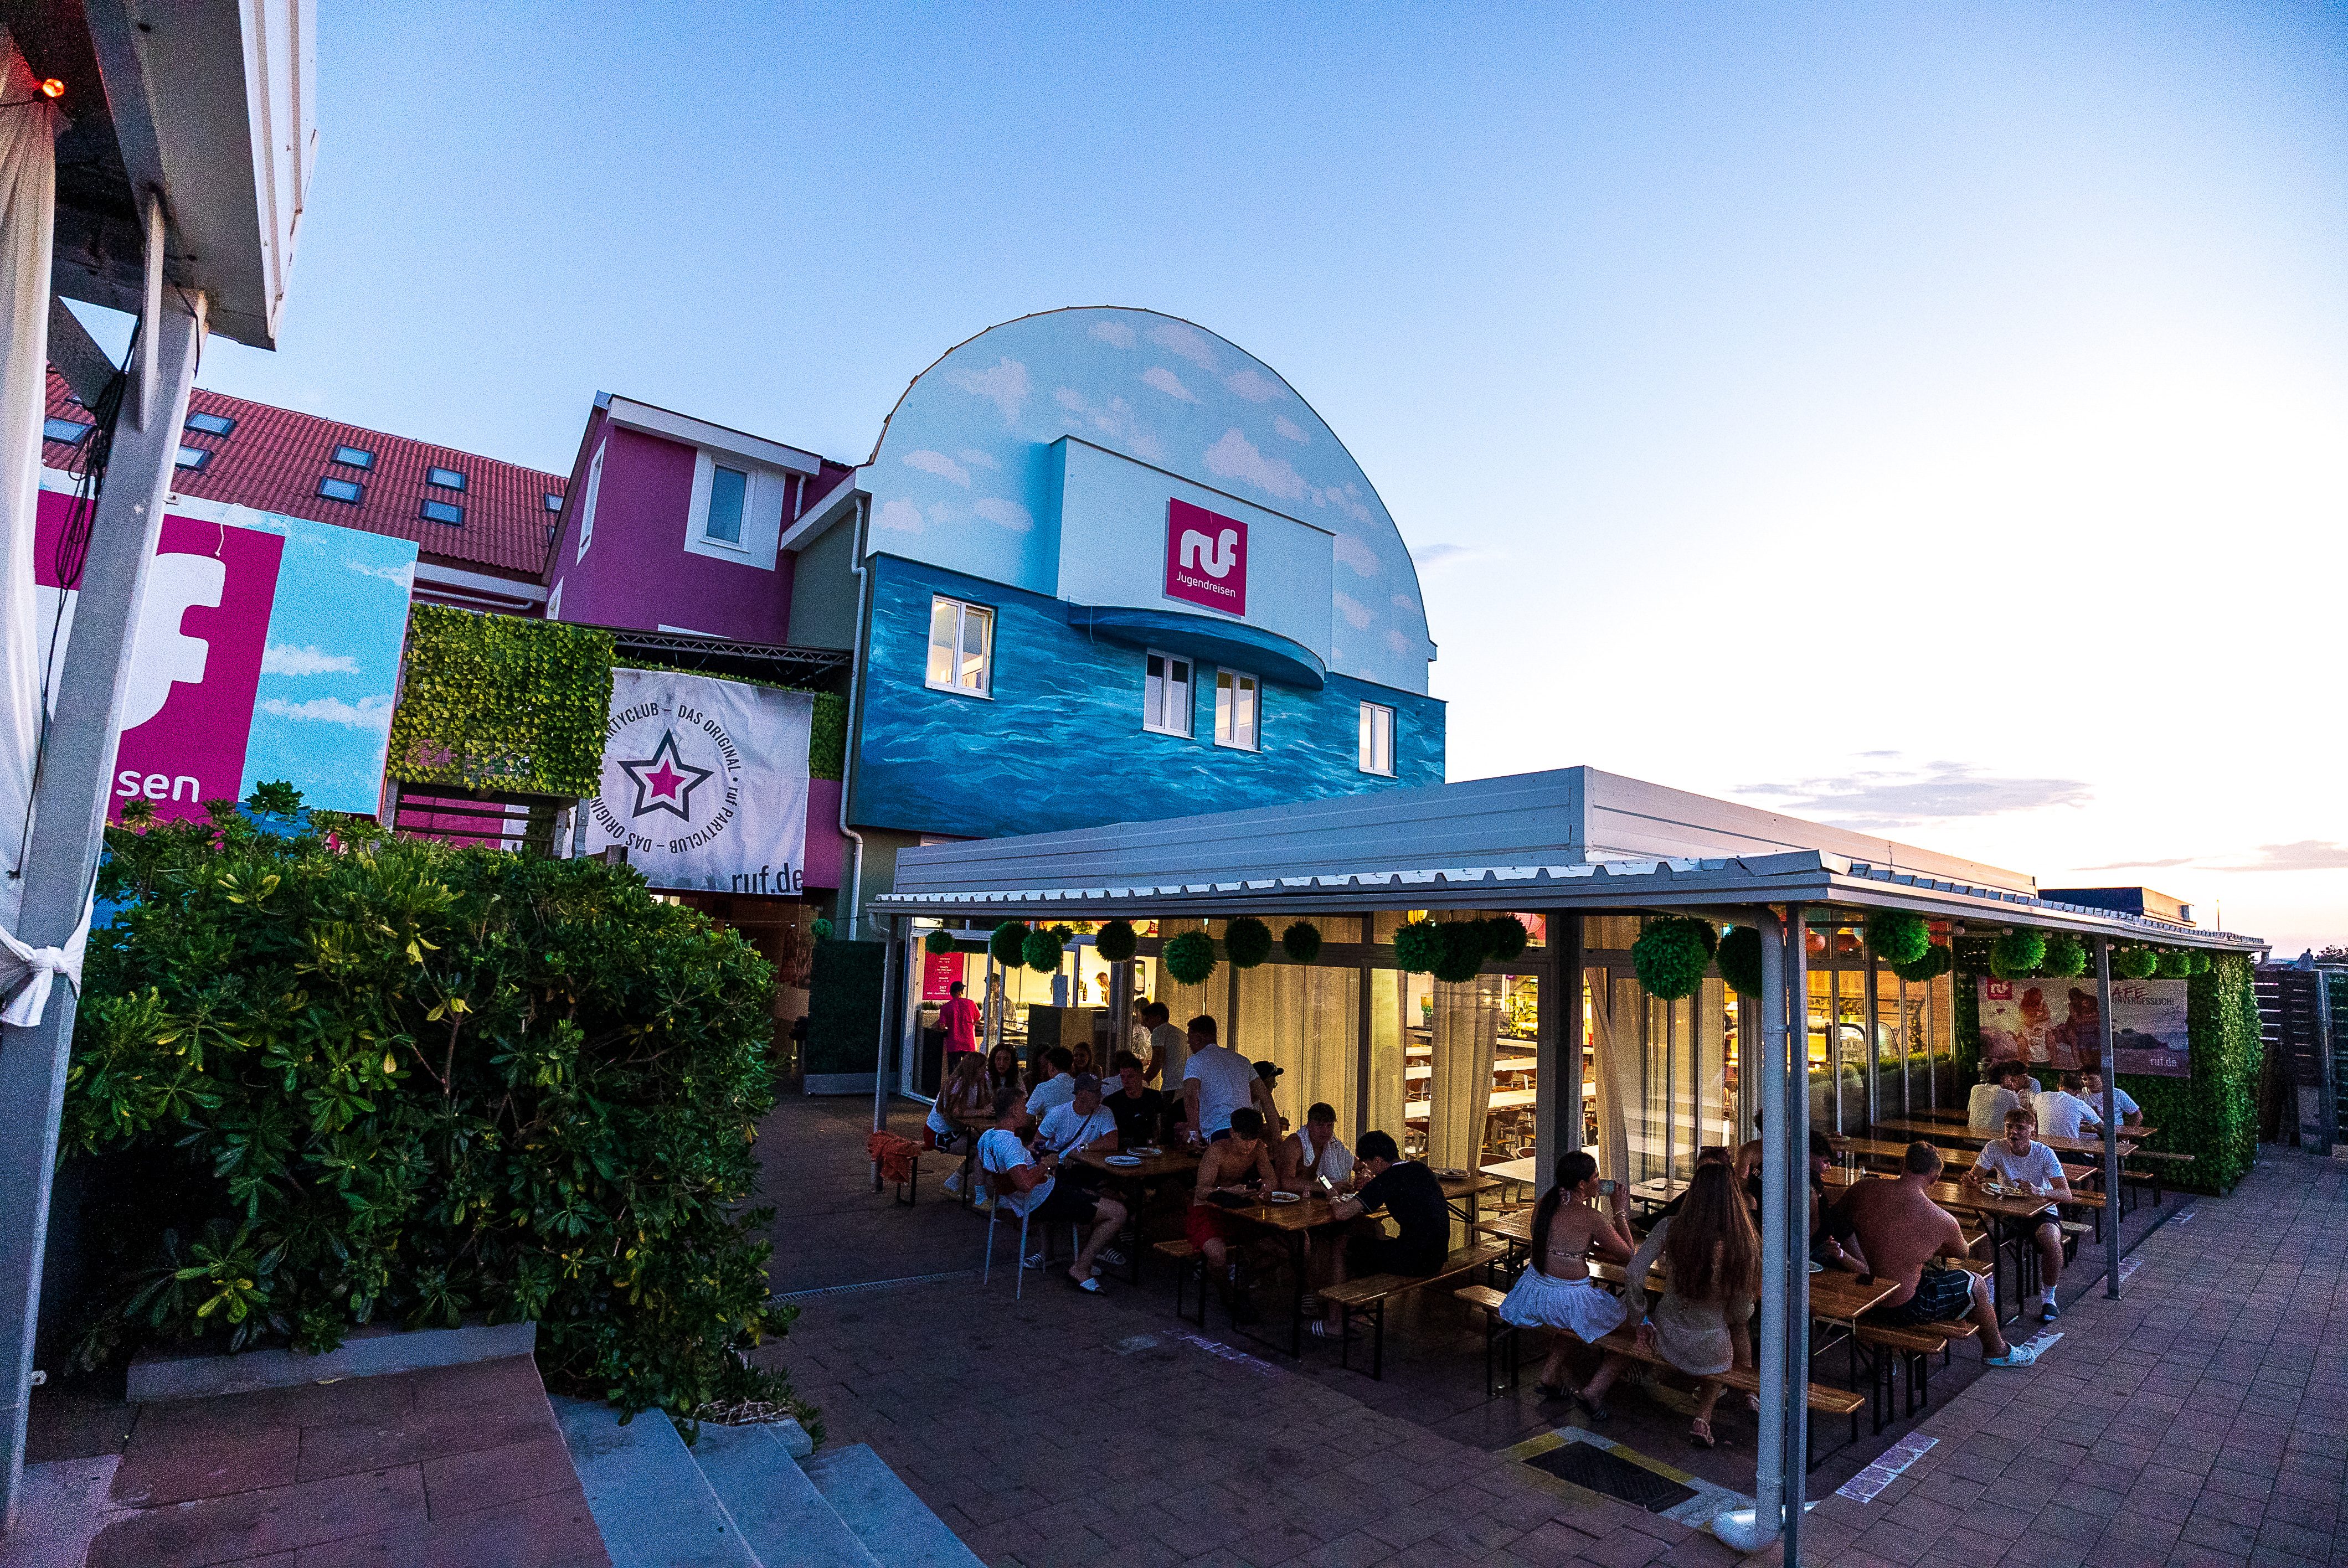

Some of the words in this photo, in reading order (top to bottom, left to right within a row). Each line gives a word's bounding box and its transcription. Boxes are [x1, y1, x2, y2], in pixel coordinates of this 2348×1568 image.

[1180, 528, 1238, 578] ruf
[1176, 571, 1235, 597] Jugendreisen
[678, 705, 703, 725] DAS
[703, 720, 742, 772] ORIGINAL
[116, 770, 200, 803] sen
[725, 787, 738, 807] ruf
[590, 797, 625, 839] ORIGIN
[670, 807, 734, 854] PARTYCLUB
[625, 833, 652, 853] DAS
[732, 863, 803, 894] ruf.de
[2112, 986, 2148, 999] AFE
[2150, 1056, 2177, 1067] ruf.de
